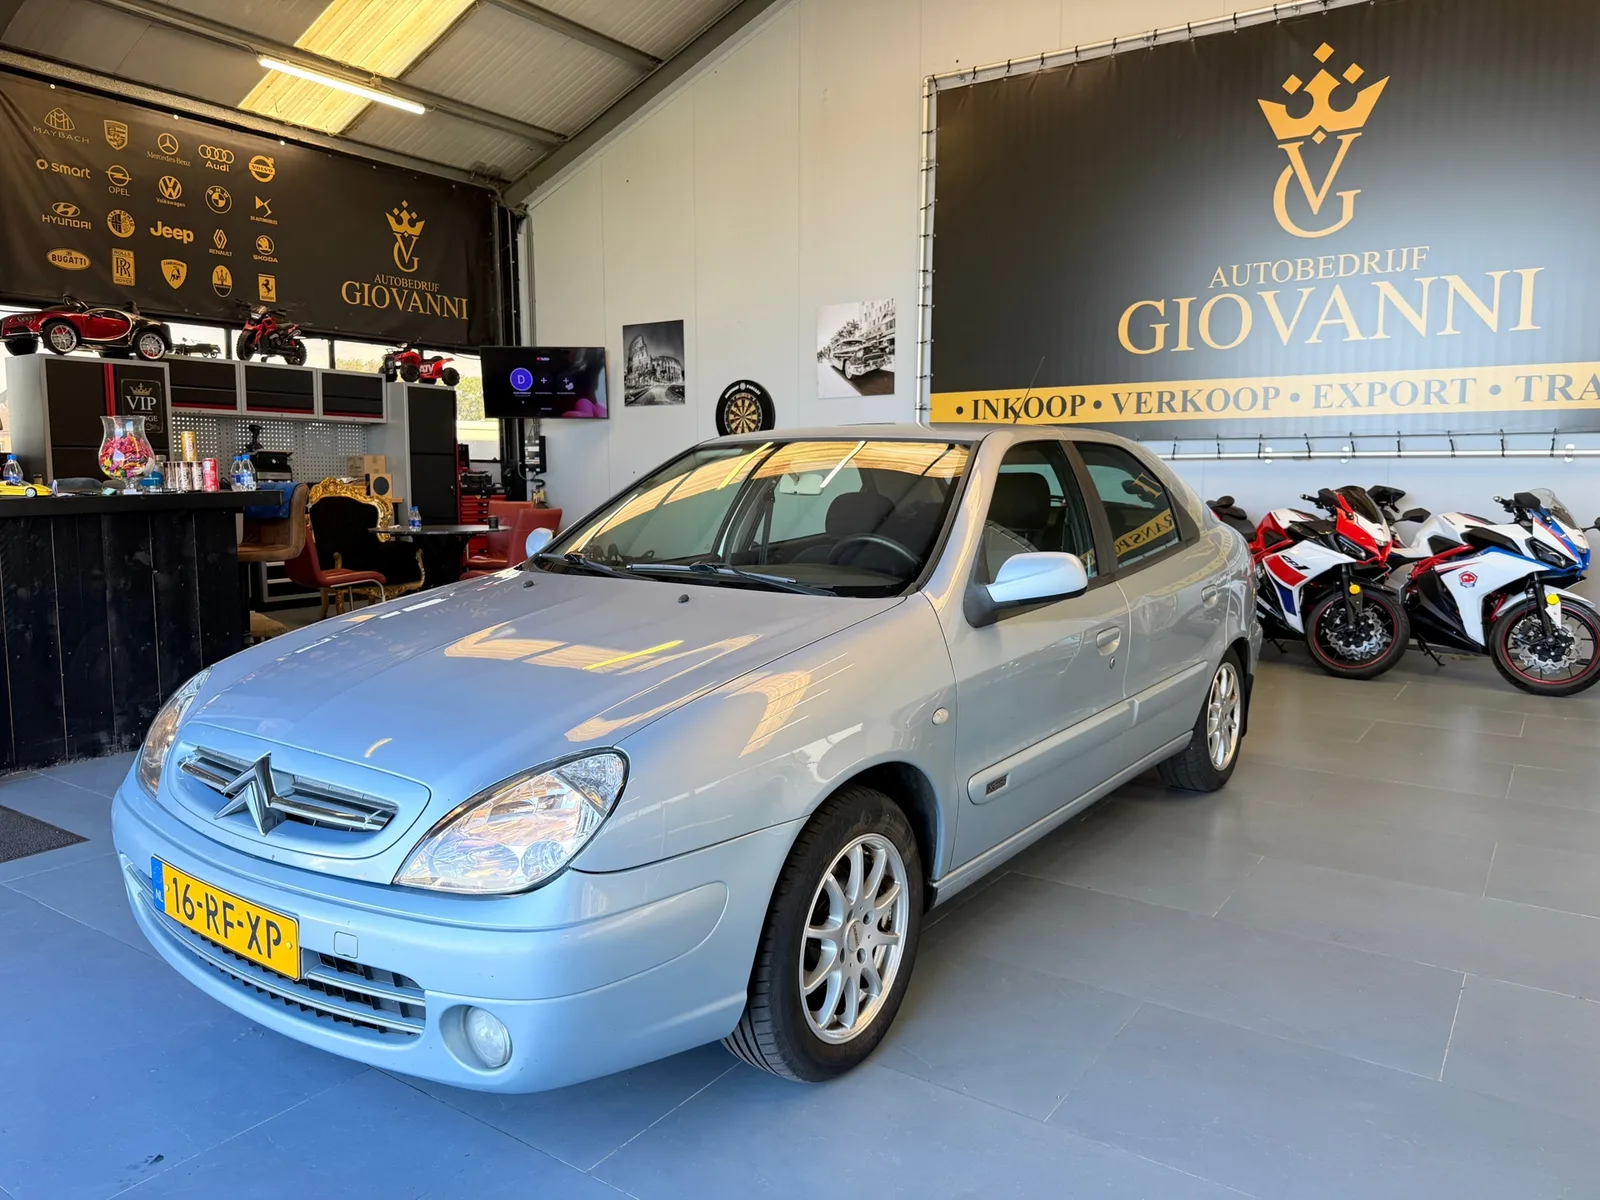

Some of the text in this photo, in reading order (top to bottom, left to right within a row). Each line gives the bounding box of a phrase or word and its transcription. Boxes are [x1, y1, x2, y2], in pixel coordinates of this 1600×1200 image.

[33, 126, 90, 144] MAYBACH
[146, 150, 191, 167] Mercedes-Benz
[205, 160, 230, 173] Audi
[51, 162, 91, 179] smart
[250, 164, 274, 174] VOLVO
[108, 185, 130, 197] OPEL
[208, 187, 229, 199] BMW
[156, 197, 186, 208] Volkswagen
[41, 214, 92, 230] HYUNDAI
[149, 221, 195, 244] Jeep
[51, 253, 87, 266] BUGATTI
[208, 248, 233, 257] RENAULT
[1207, 245, 1430, 289] AUTOBEDRIJF
[374, 273, 440, 293] AUTOBEDRIJF
[341, 280, 469, 320] GIOVANNI
[1117, 267, 1545, 355] GIOVANNI
[517, 374, 526, 385] D
[125, 395, 157, 411] VIP
[972, 372, 1600, 420] INKOOP VERKOOP EXPORT TRA
[155, 888, 164, 903] NL
[172, 876, 282, 959] 16-RF-XP
